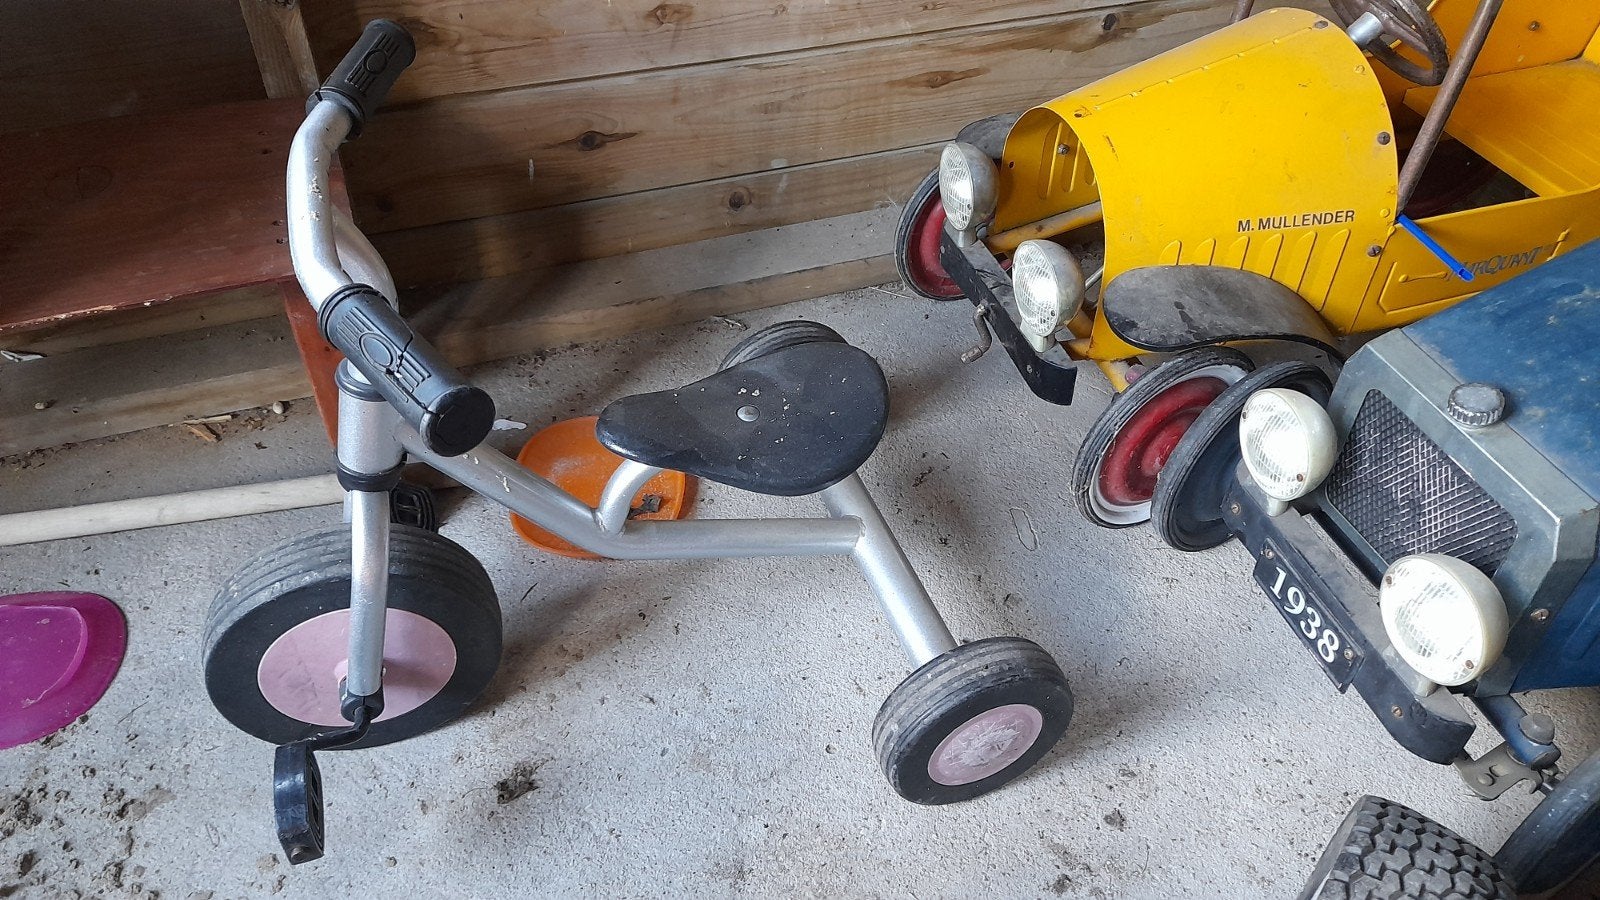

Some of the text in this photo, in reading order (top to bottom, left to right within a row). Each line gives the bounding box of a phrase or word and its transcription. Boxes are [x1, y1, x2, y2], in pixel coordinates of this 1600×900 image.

[1238, 210, 1355, 232] M. MULLENDER
[1269, 566, 1340, 663] 1938
